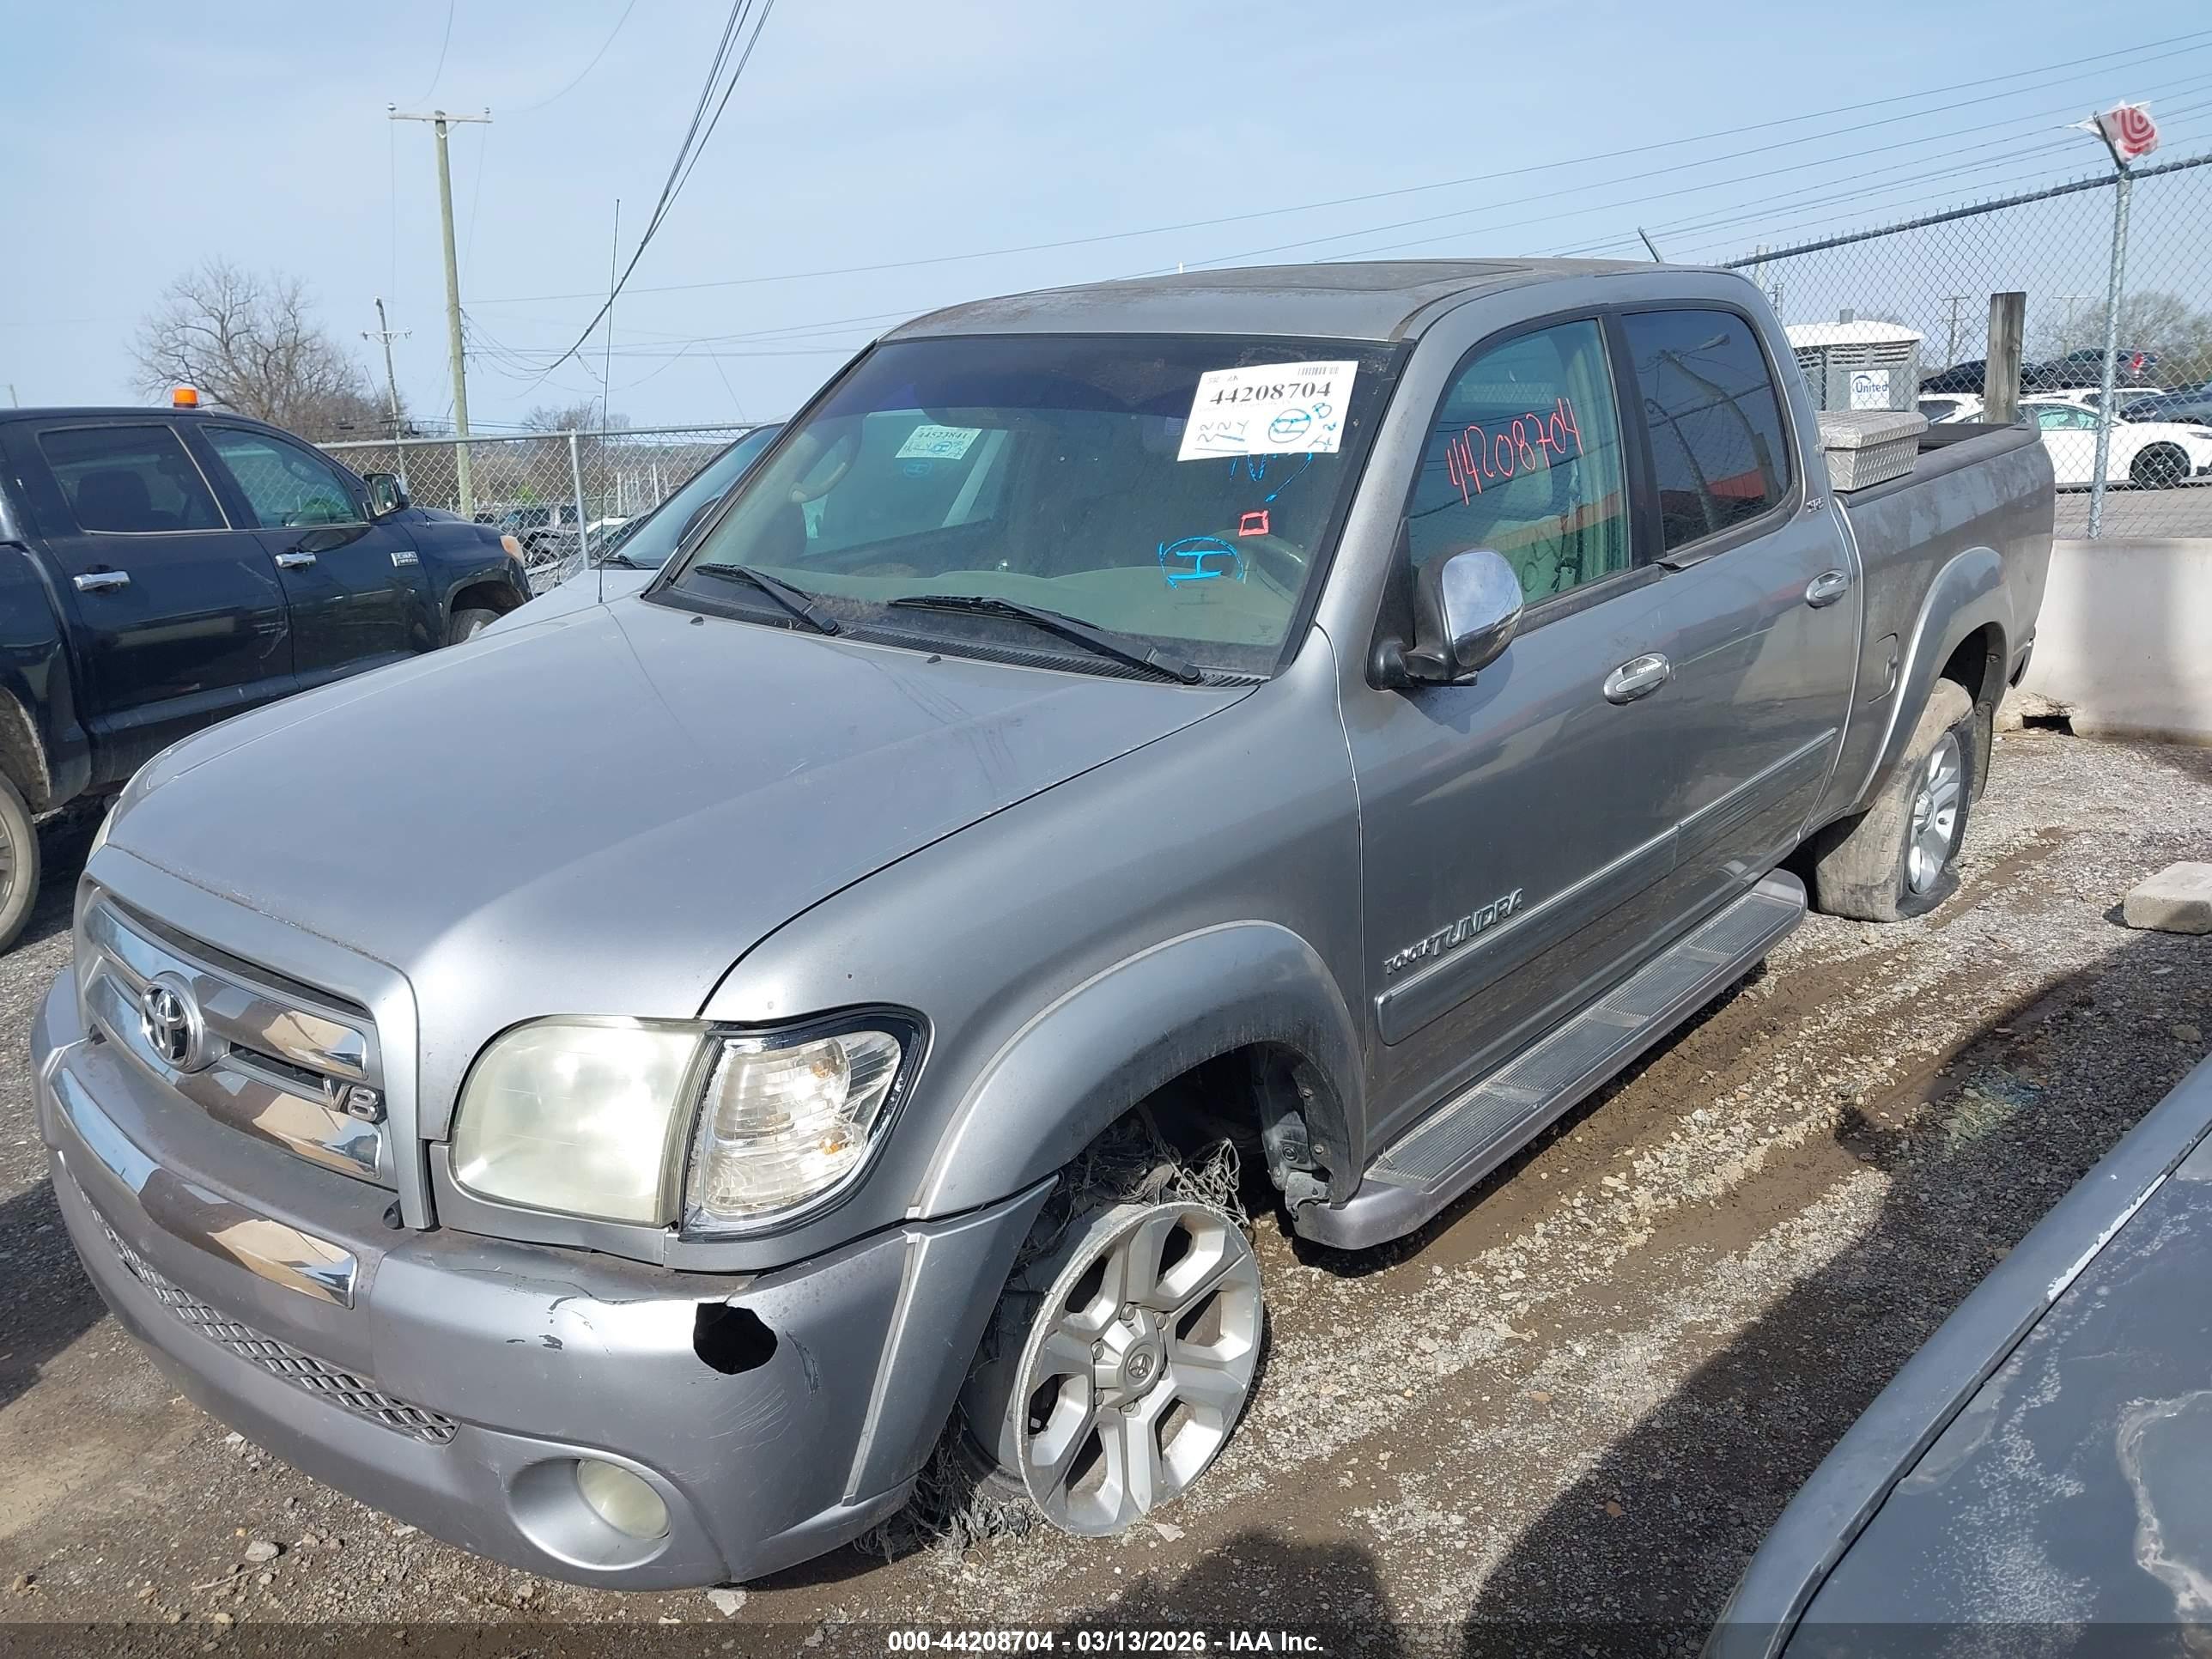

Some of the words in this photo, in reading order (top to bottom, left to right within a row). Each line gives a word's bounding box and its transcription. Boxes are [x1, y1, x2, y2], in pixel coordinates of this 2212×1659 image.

[1209, 381, 1331, 404] 44208704
[1855, 380, 1888, 393] United
[1446, 397, 1584, 507] 44208704
[1430, 887, 1524, 957] TUNDRA
[323, 1077, 379, 1121] V8
